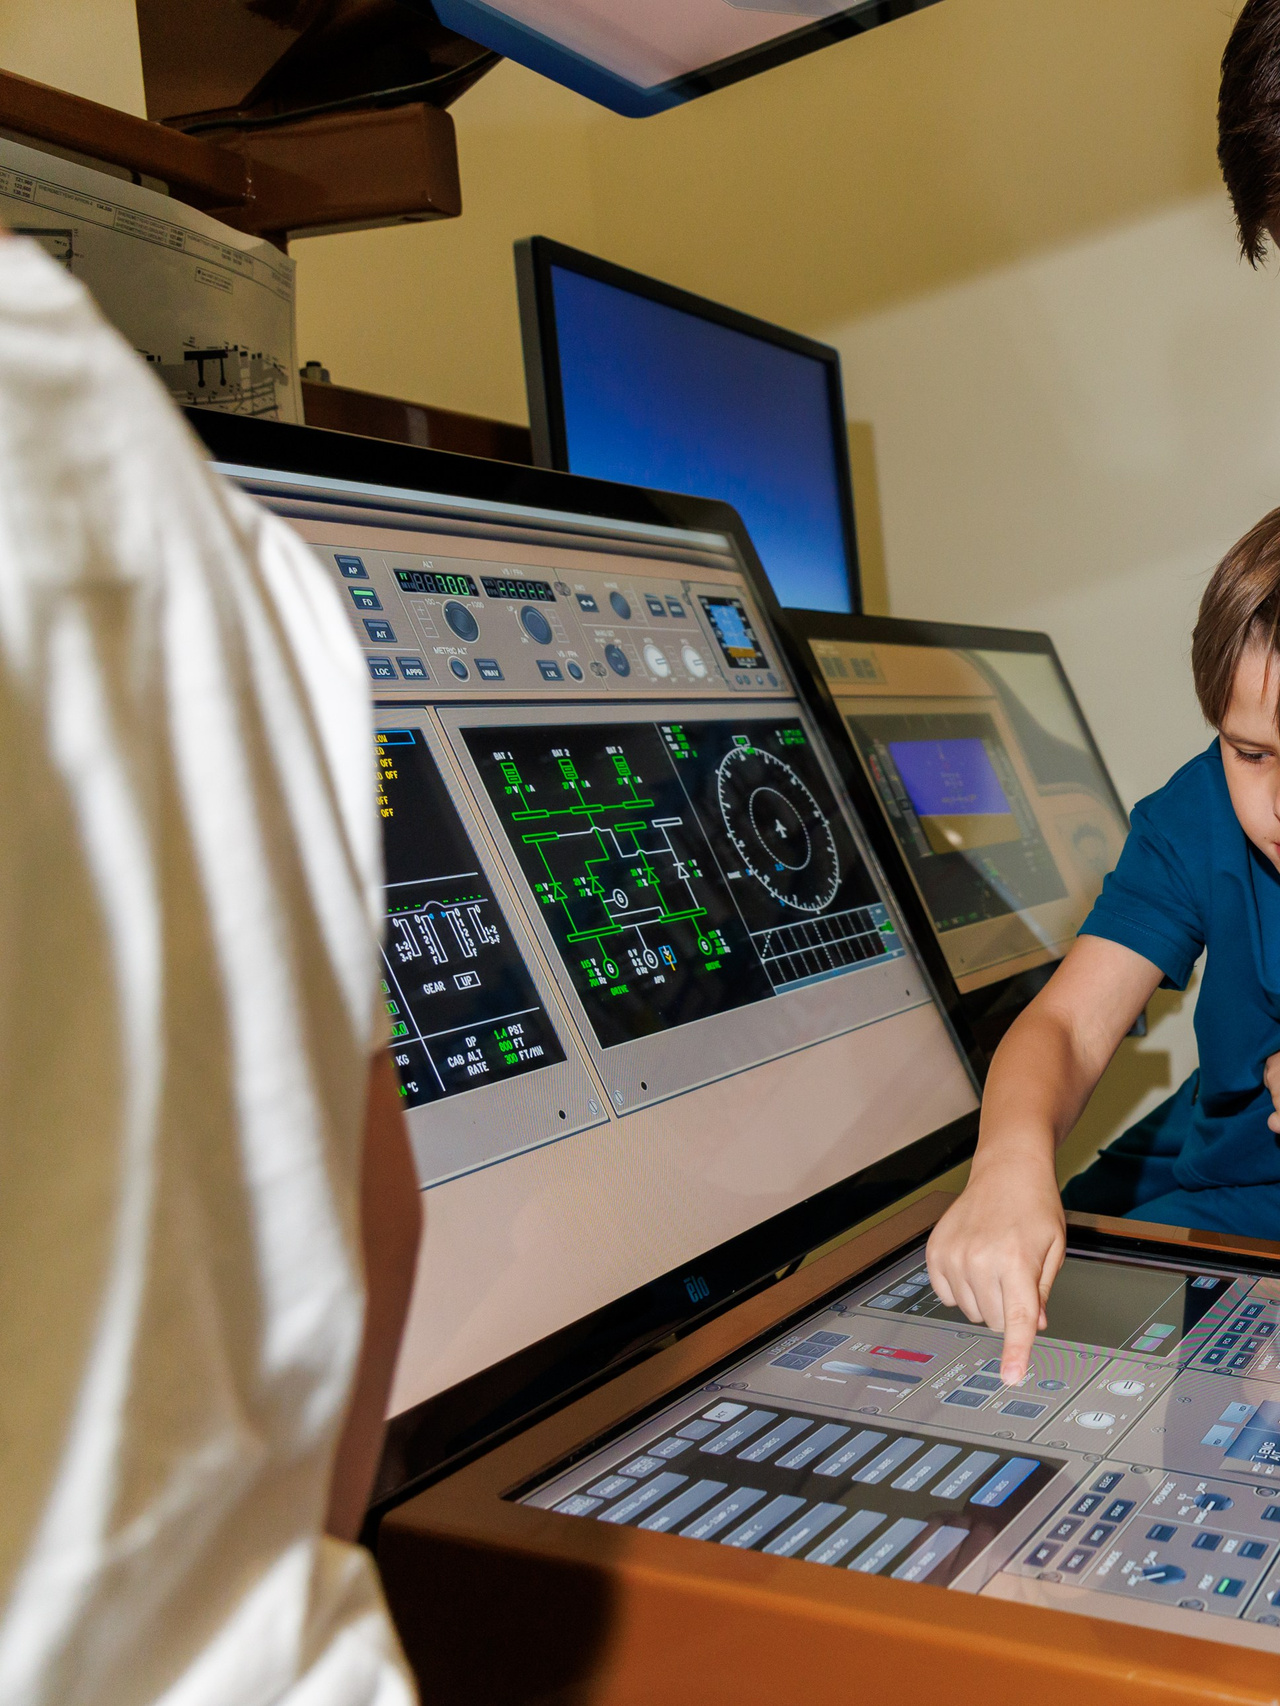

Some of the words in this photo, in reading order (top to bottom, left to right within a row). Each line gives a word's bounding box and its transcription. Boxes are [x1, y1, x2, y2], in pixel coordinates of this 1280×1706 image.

[348, 566, 358, 575] AP
[362, 598, 373, 606] FD
[374, 667, 391, 676] LOC
[405, 668, 423, 677] APPR
[460, 975, 472, 988] UP
[423, 981, 446, 995] GEAR
[465, 1036, 477, 1048] DP
[494, 1028, 508, 1040] 1.4
[507, 1024, 525, 1037] PSI
[447, 1054, 465, 1068] CAB
[466, 1049, 484, 1063] ALT
[513, 1037, 525, 1049] FT
[395, 1054, 410, 1066] KG
[466, 1061, 489, 1077] RATE
